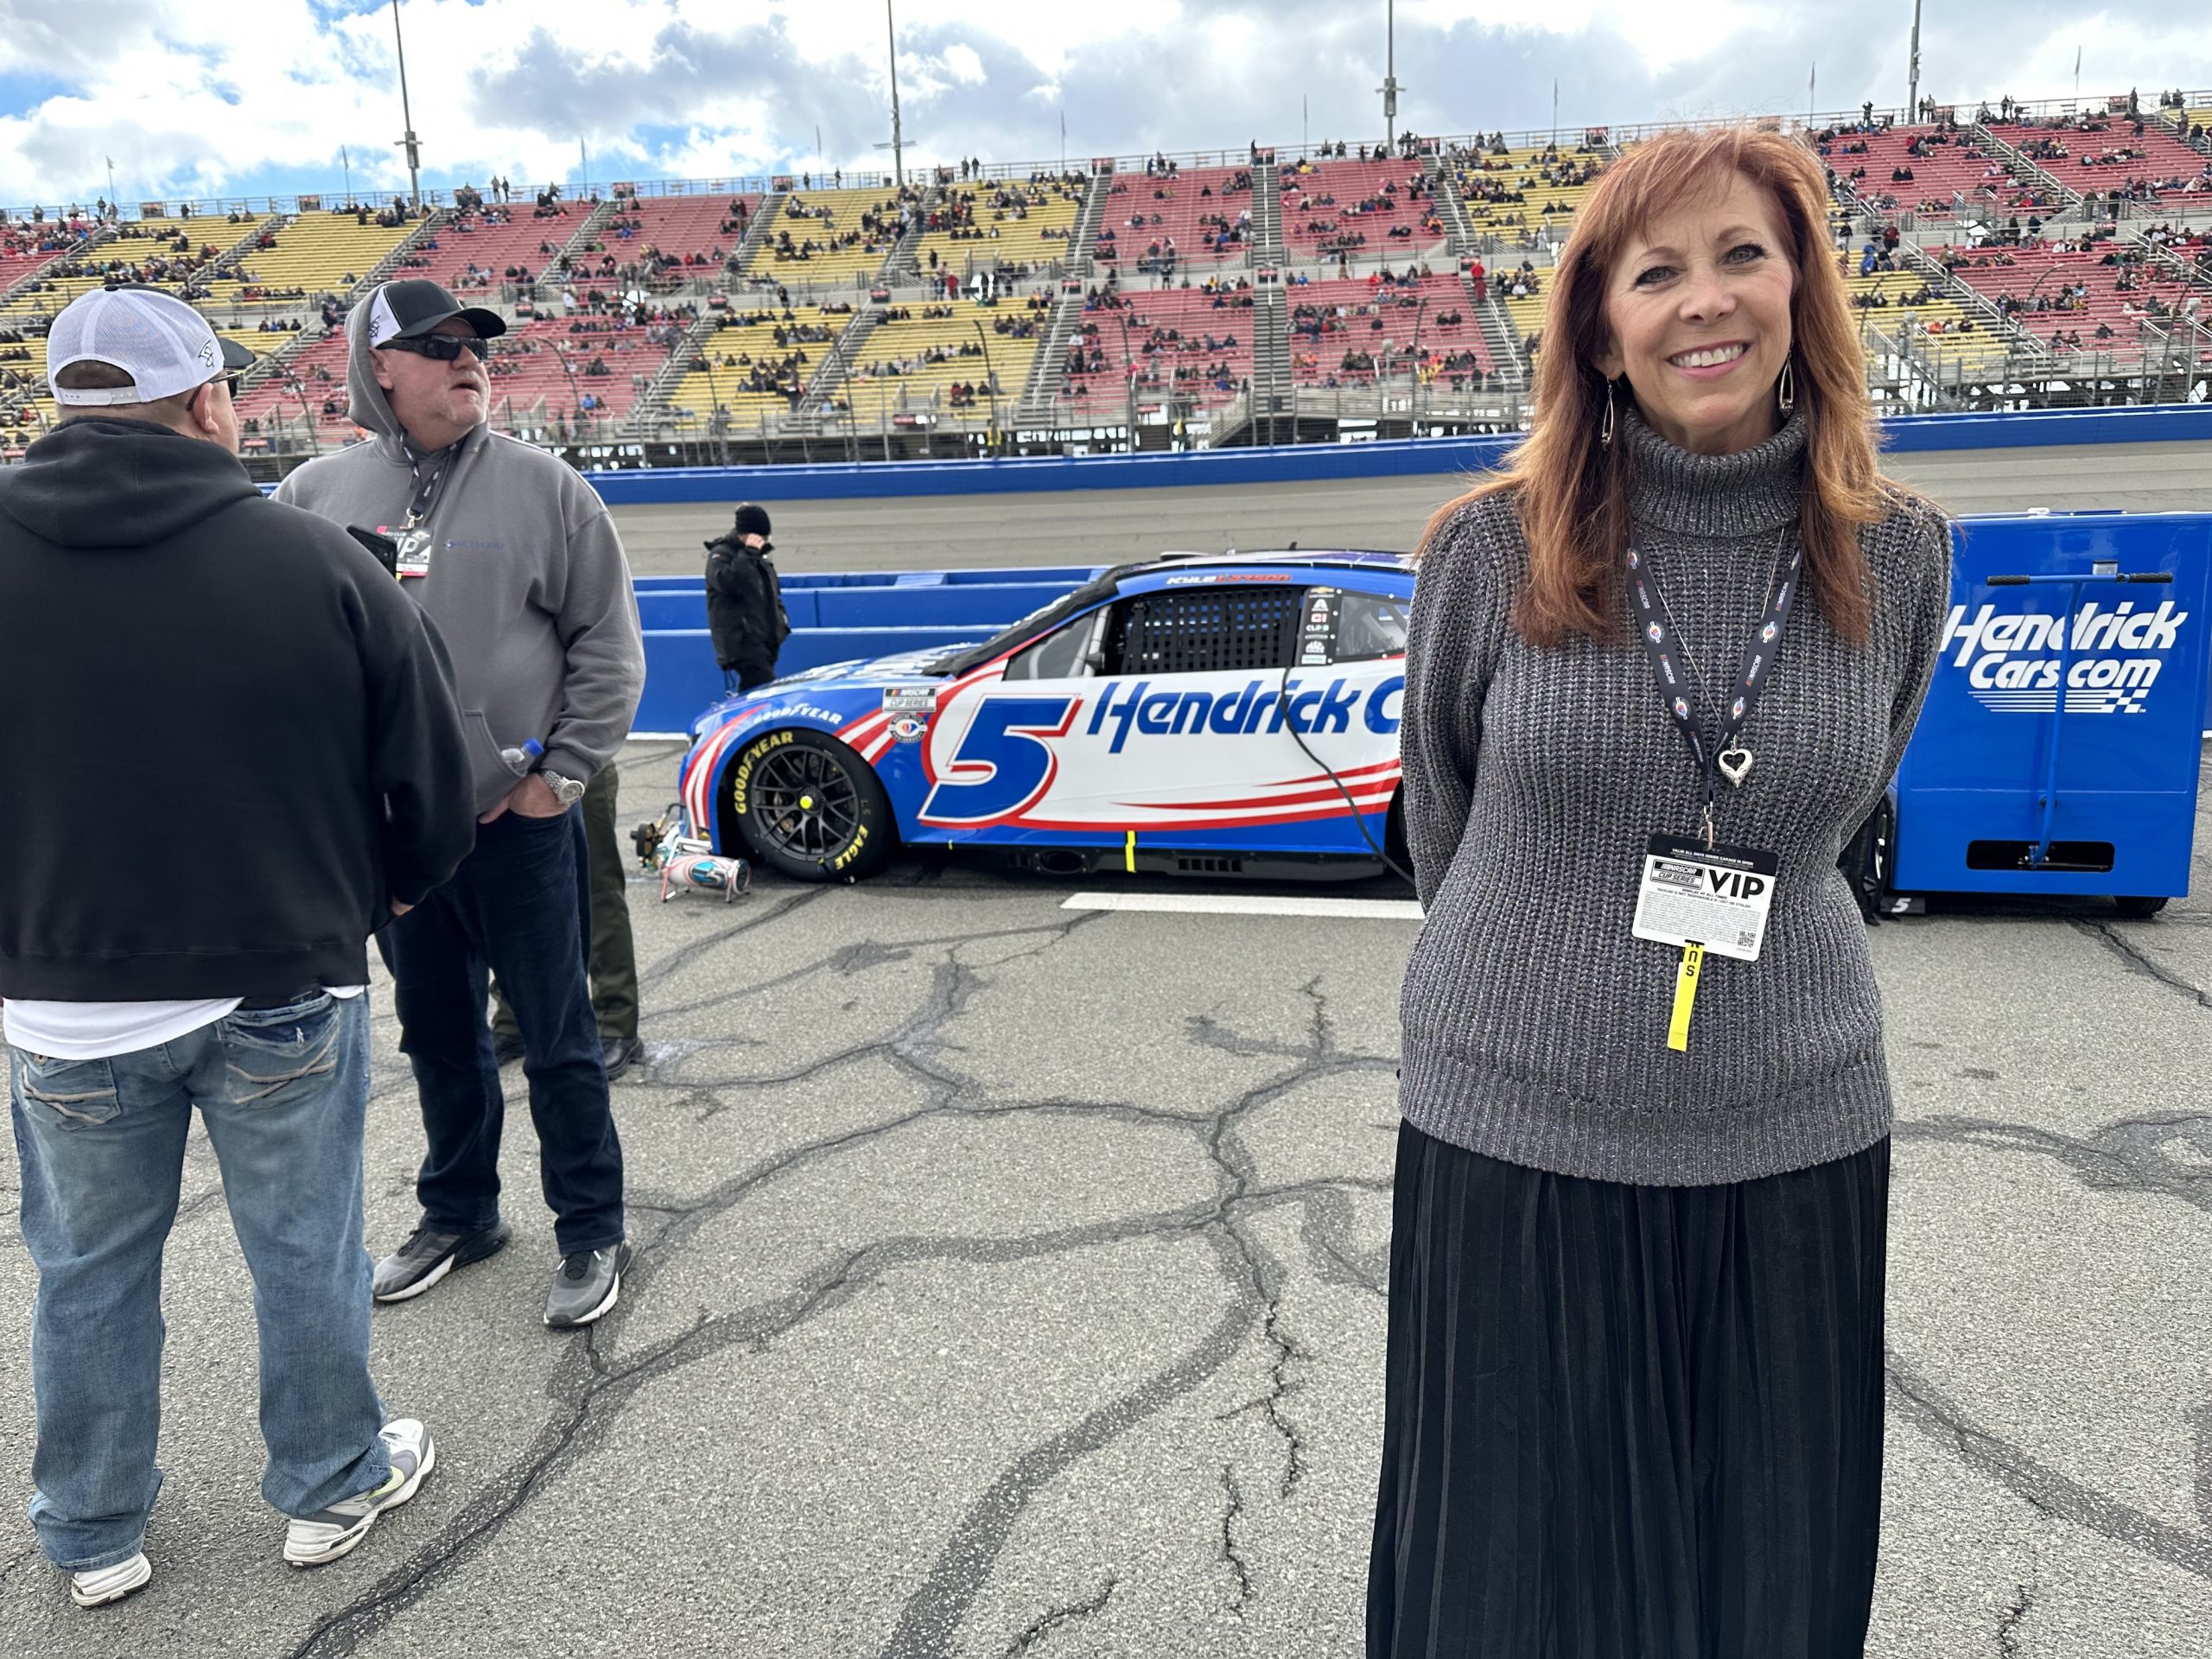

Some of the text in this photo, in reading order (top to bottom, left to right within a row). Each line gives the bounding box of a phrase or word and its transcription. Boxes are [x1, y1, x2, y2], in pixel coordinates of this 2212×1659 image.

[1166, 575, 1217, 585] KYLE
[1940, 601, 2189, 667] Hendrick
[1662, 658, 1675, 684] NASCAR
[1750, 654, 1763, 682] NASCAR
[1969, 652, 2162, 689] Carscom
[753, 702, 842, 725] GOODYEAR
[891, 698, 929, 707] CUP SERIES
[1086, 678, 1362, 753] Hendrick
[734, 731, 794, 815] GOODYEAR
[917, 694, 1082, 825] 5
[834, 824, 869, 870] EAGLE
[1658, 871, 1696, 884] CUP SERIES
[1669, 862, 1698, 874] NASCAR
[1709, 868, 1765, 899] VIP
[1891, 898, 1911, 912] 5
